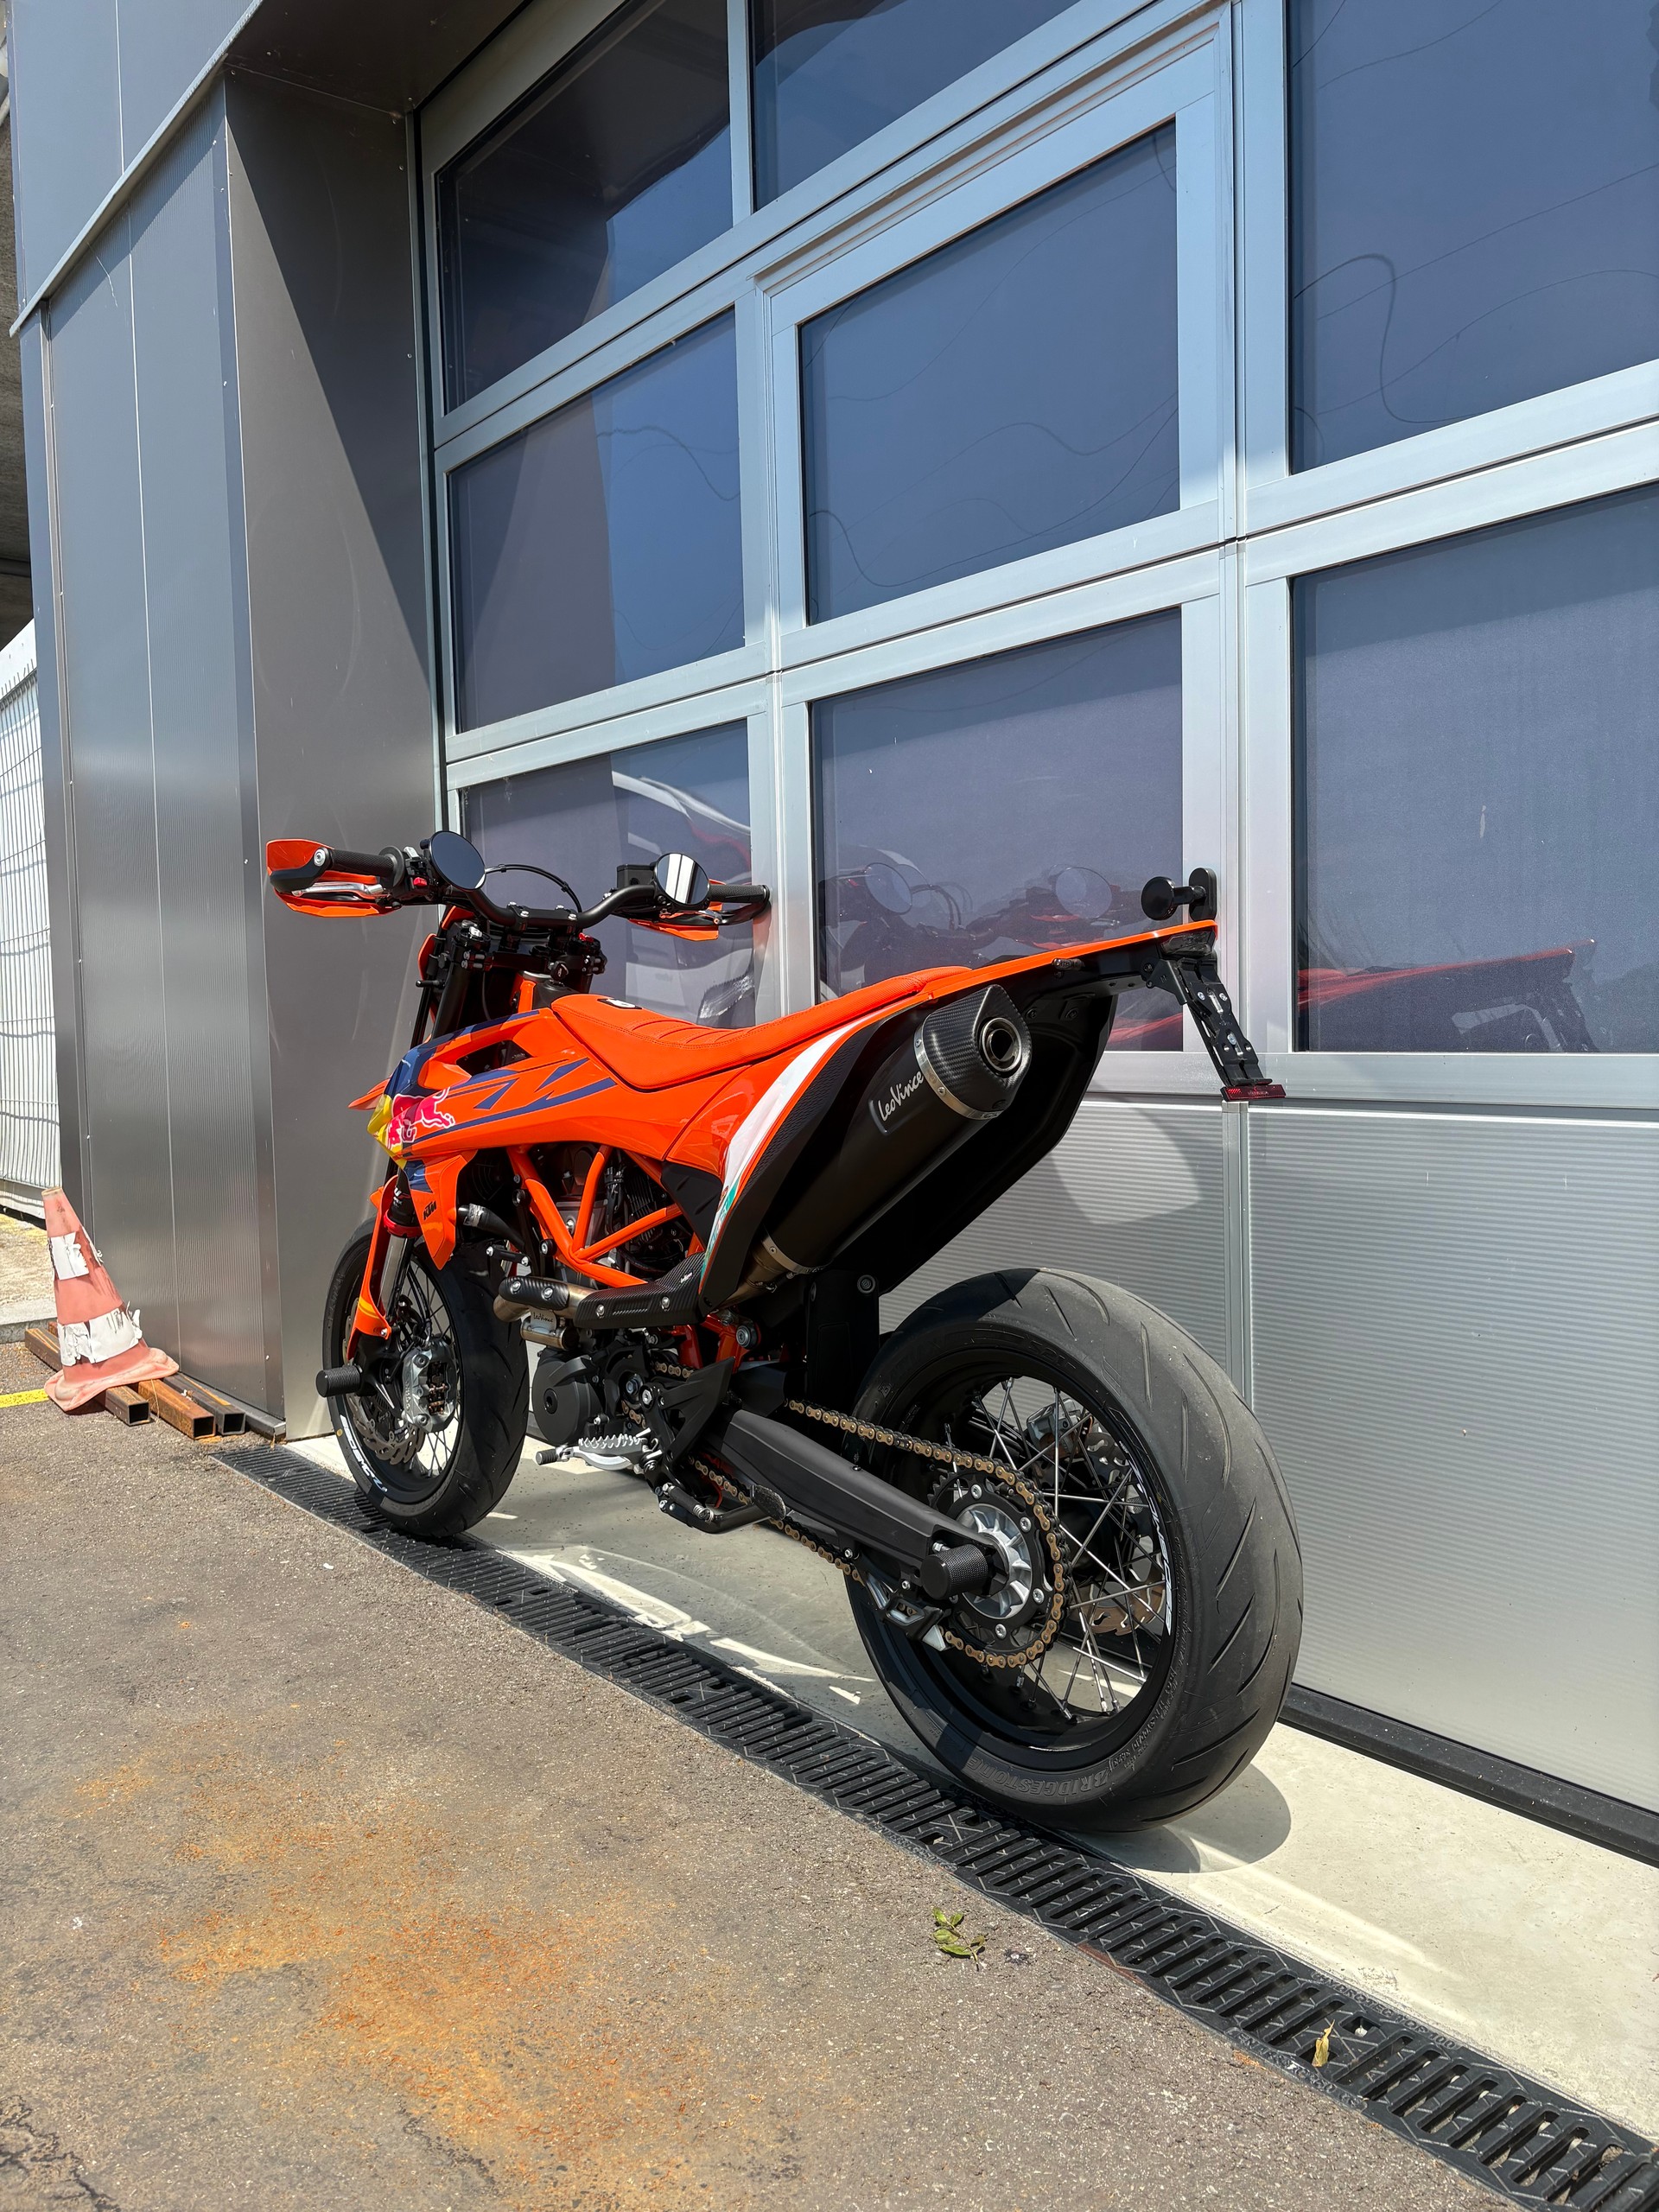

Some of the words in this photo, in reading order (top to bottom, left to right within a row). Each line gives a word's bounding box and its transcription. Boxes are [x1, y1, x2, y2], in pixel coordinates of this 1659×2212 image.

[878, 1071, 925, 1122] LeoVince
[423, 1199, 437, 1220] KTM
[967, 1755, 1109, 1796] BRIDGESTONE
[1427, 2029, 1456, 2050] 100
